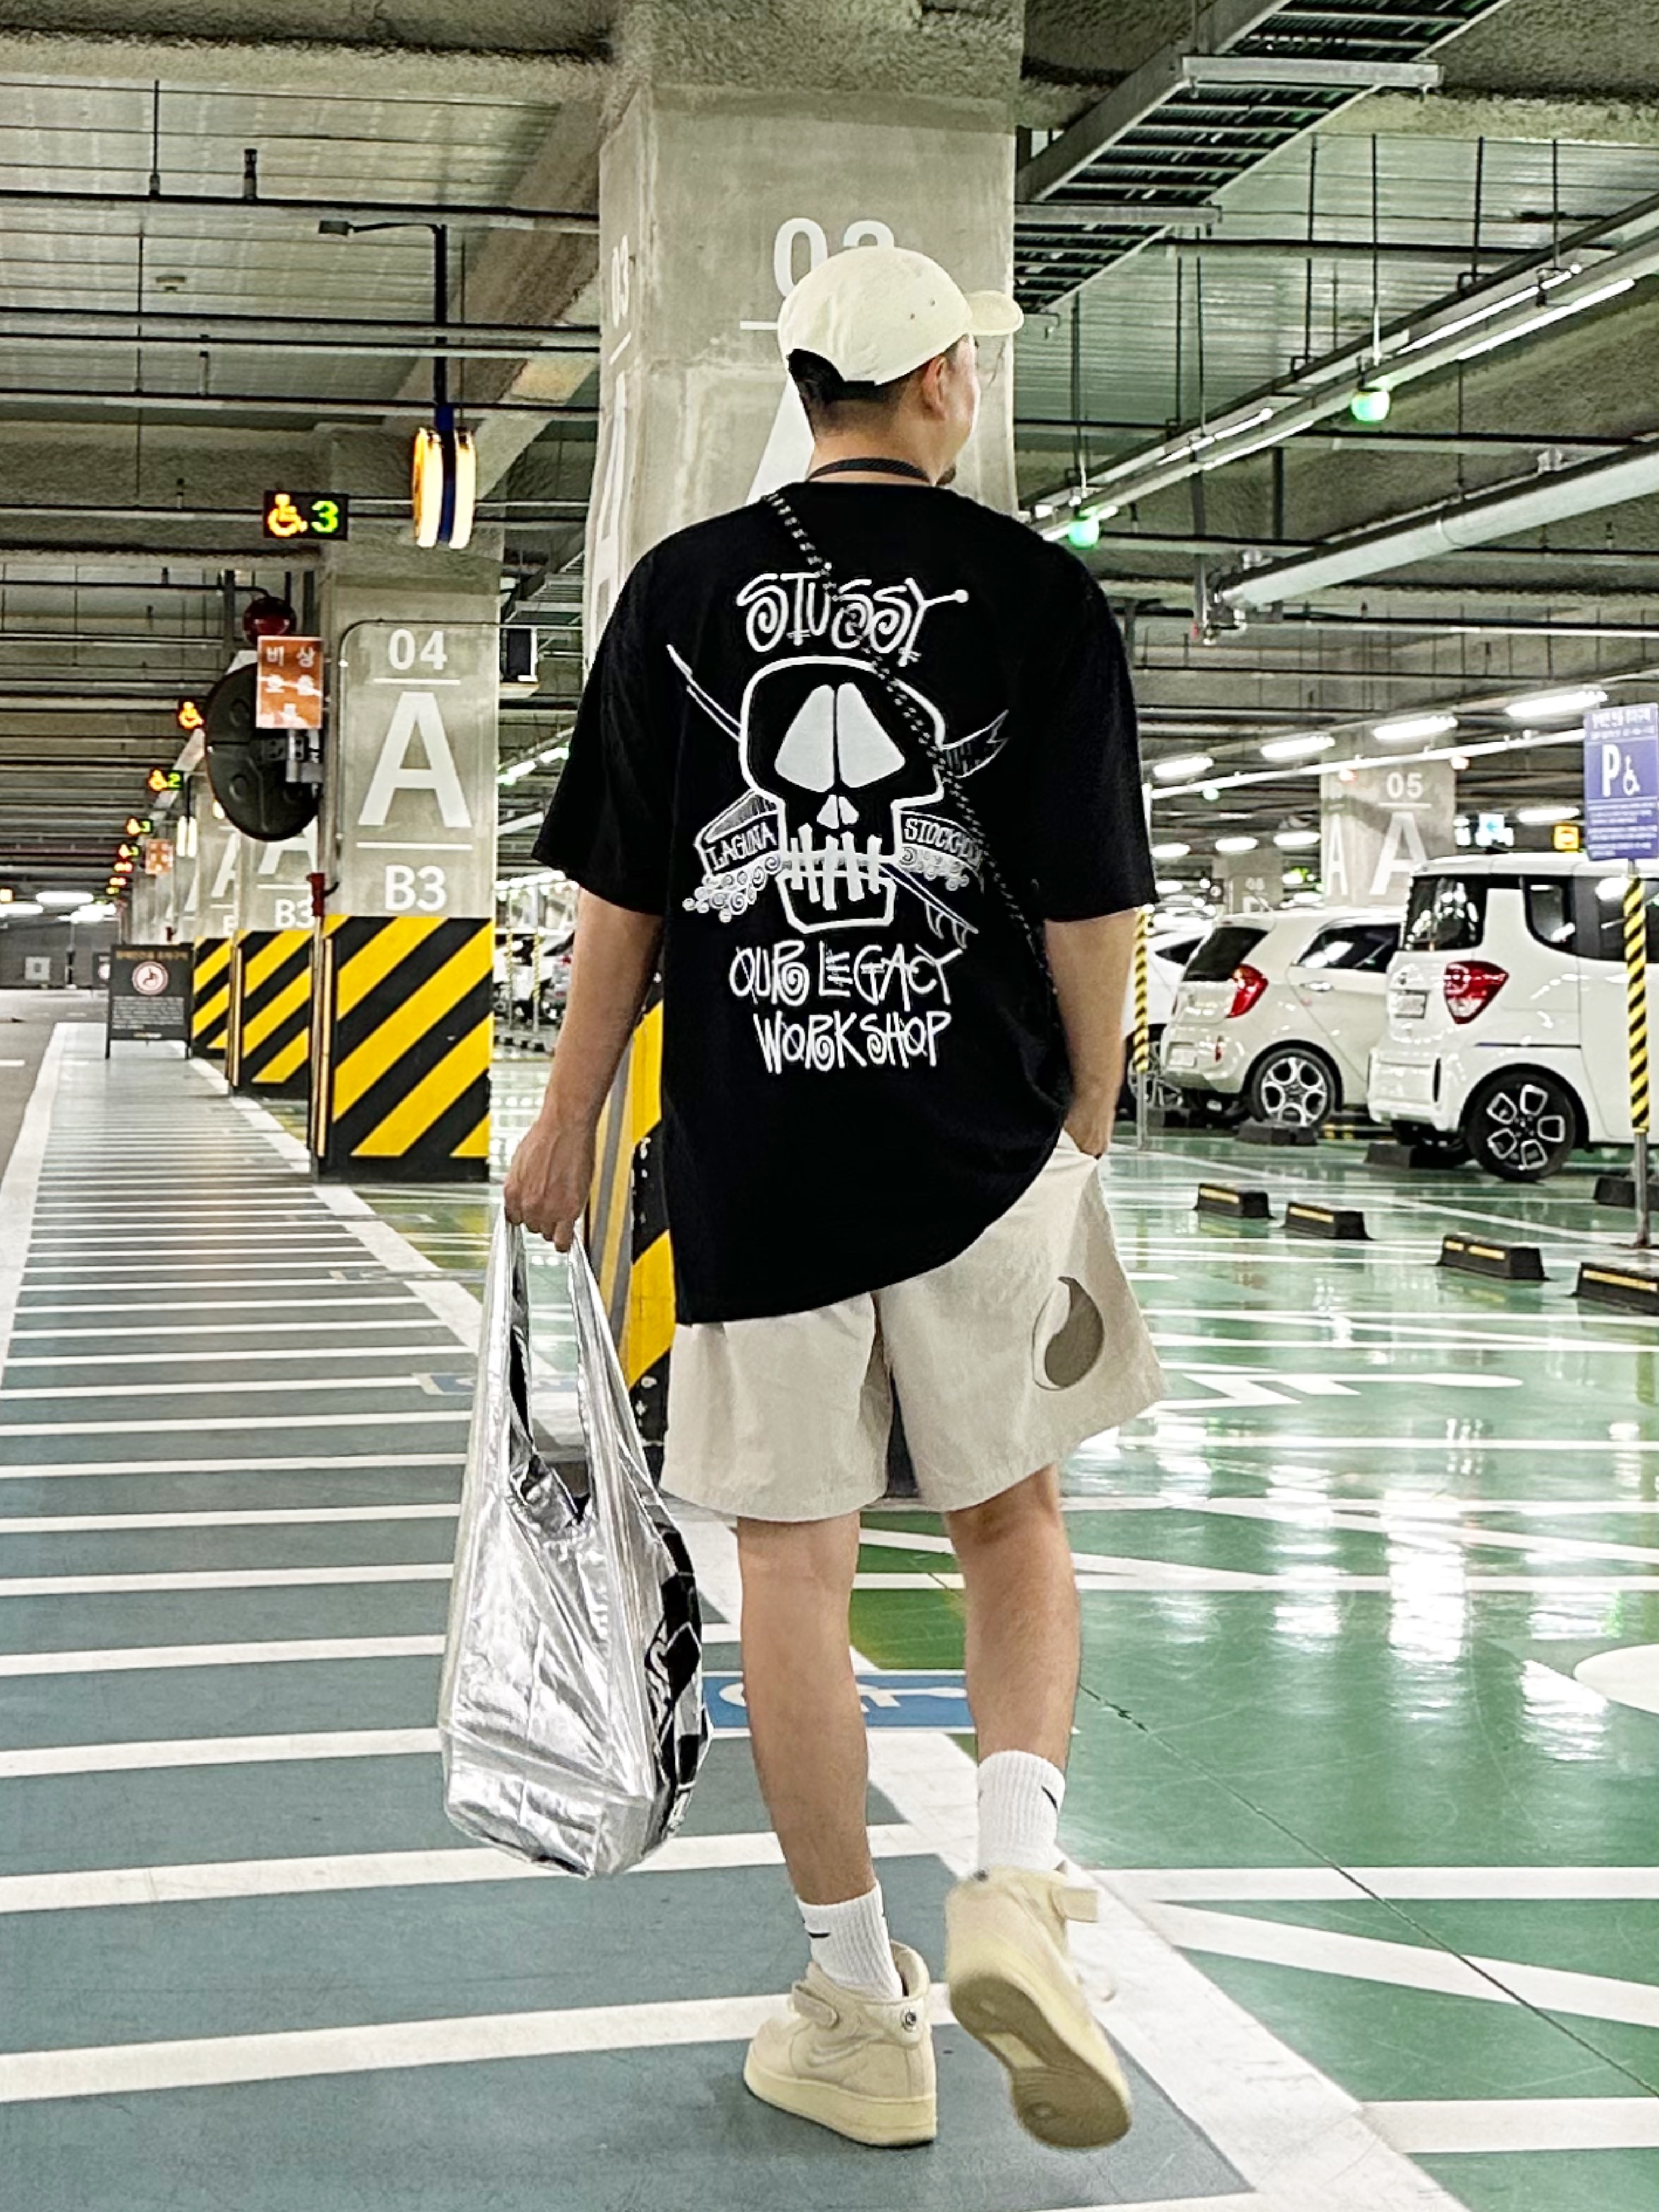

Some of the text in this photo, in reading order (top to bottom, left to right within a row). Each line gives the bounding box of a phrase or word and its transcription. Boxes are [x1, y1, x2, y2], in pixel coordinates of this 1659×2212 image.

[311, 500, 339, 533] 3
[388, 629, 448, 670] 04
[358, 691, 473, 828] A
[1602, 743, 1621, 797] P
[1386, 771, 1425, 799] 05
[704, 821, 777, 871] LAGUNA
[385, 864, 447, 911] B3
[275, 898, 316, 928] B3
[729, 939, 964, 1012] OUR LEGACY
[752, 1009, 952, 1075] WORKSHOP
